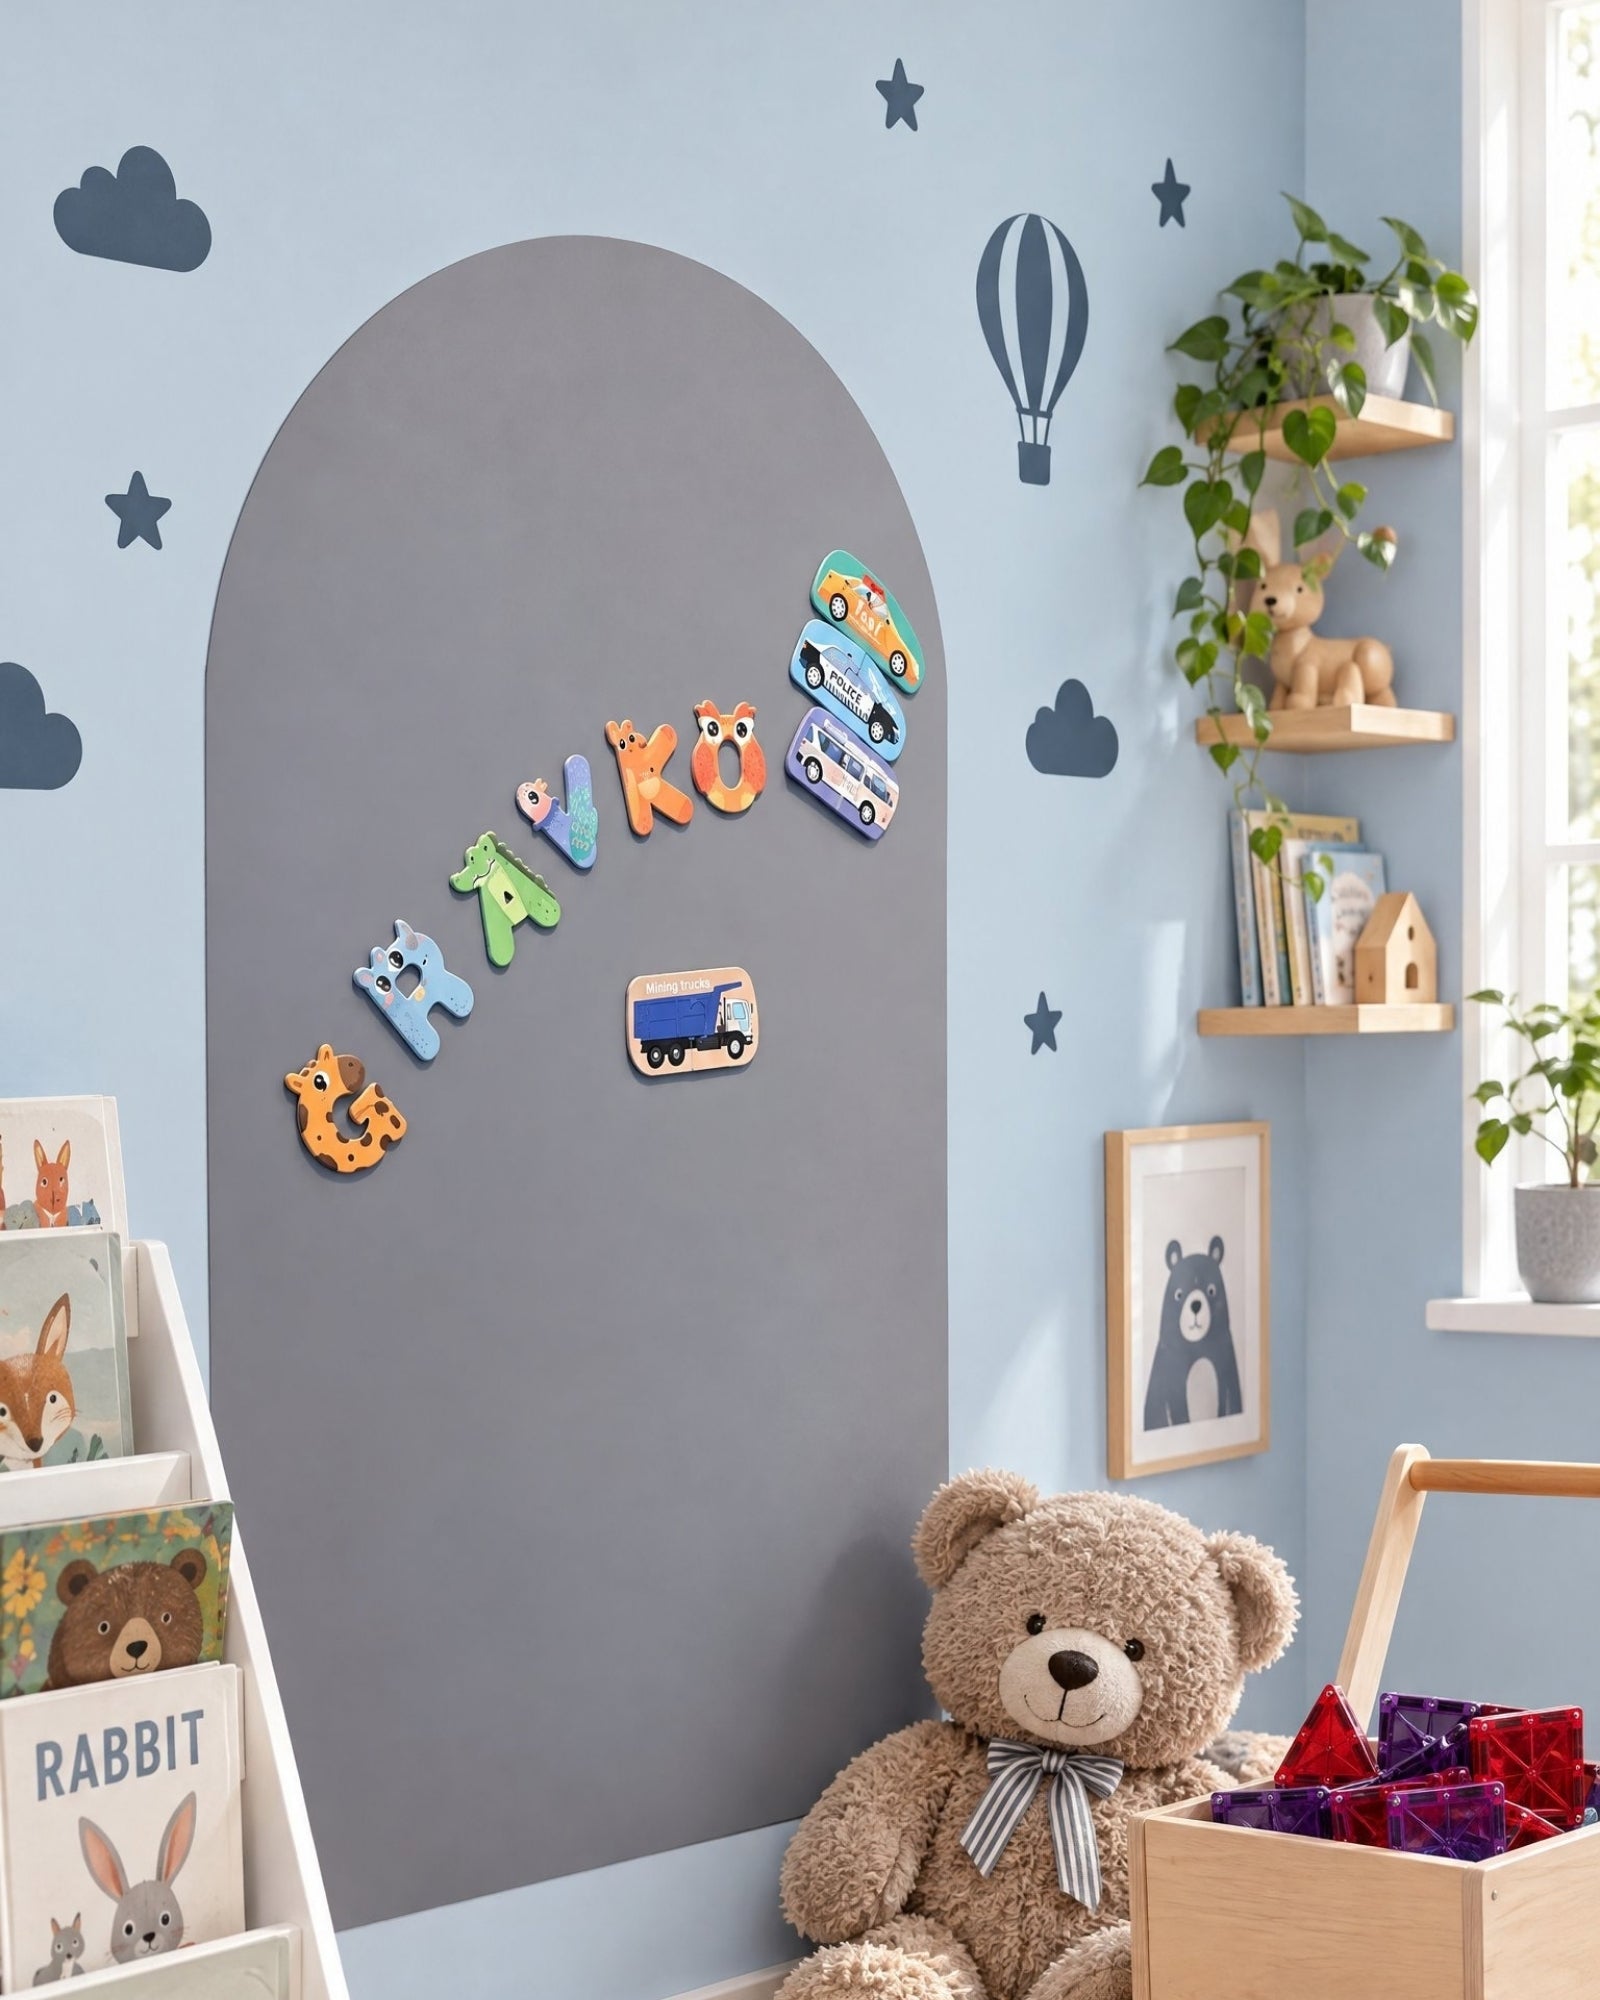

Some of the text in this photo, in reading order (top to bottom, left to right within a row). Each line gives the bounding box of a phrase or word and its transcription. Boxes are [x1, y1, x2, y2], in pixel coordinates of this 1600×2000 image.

[830, 670, 862, 706] POLICE
[645, 977, 711, 995] Mining trucks
[36, 1709, 204, 1802] RABBIT
